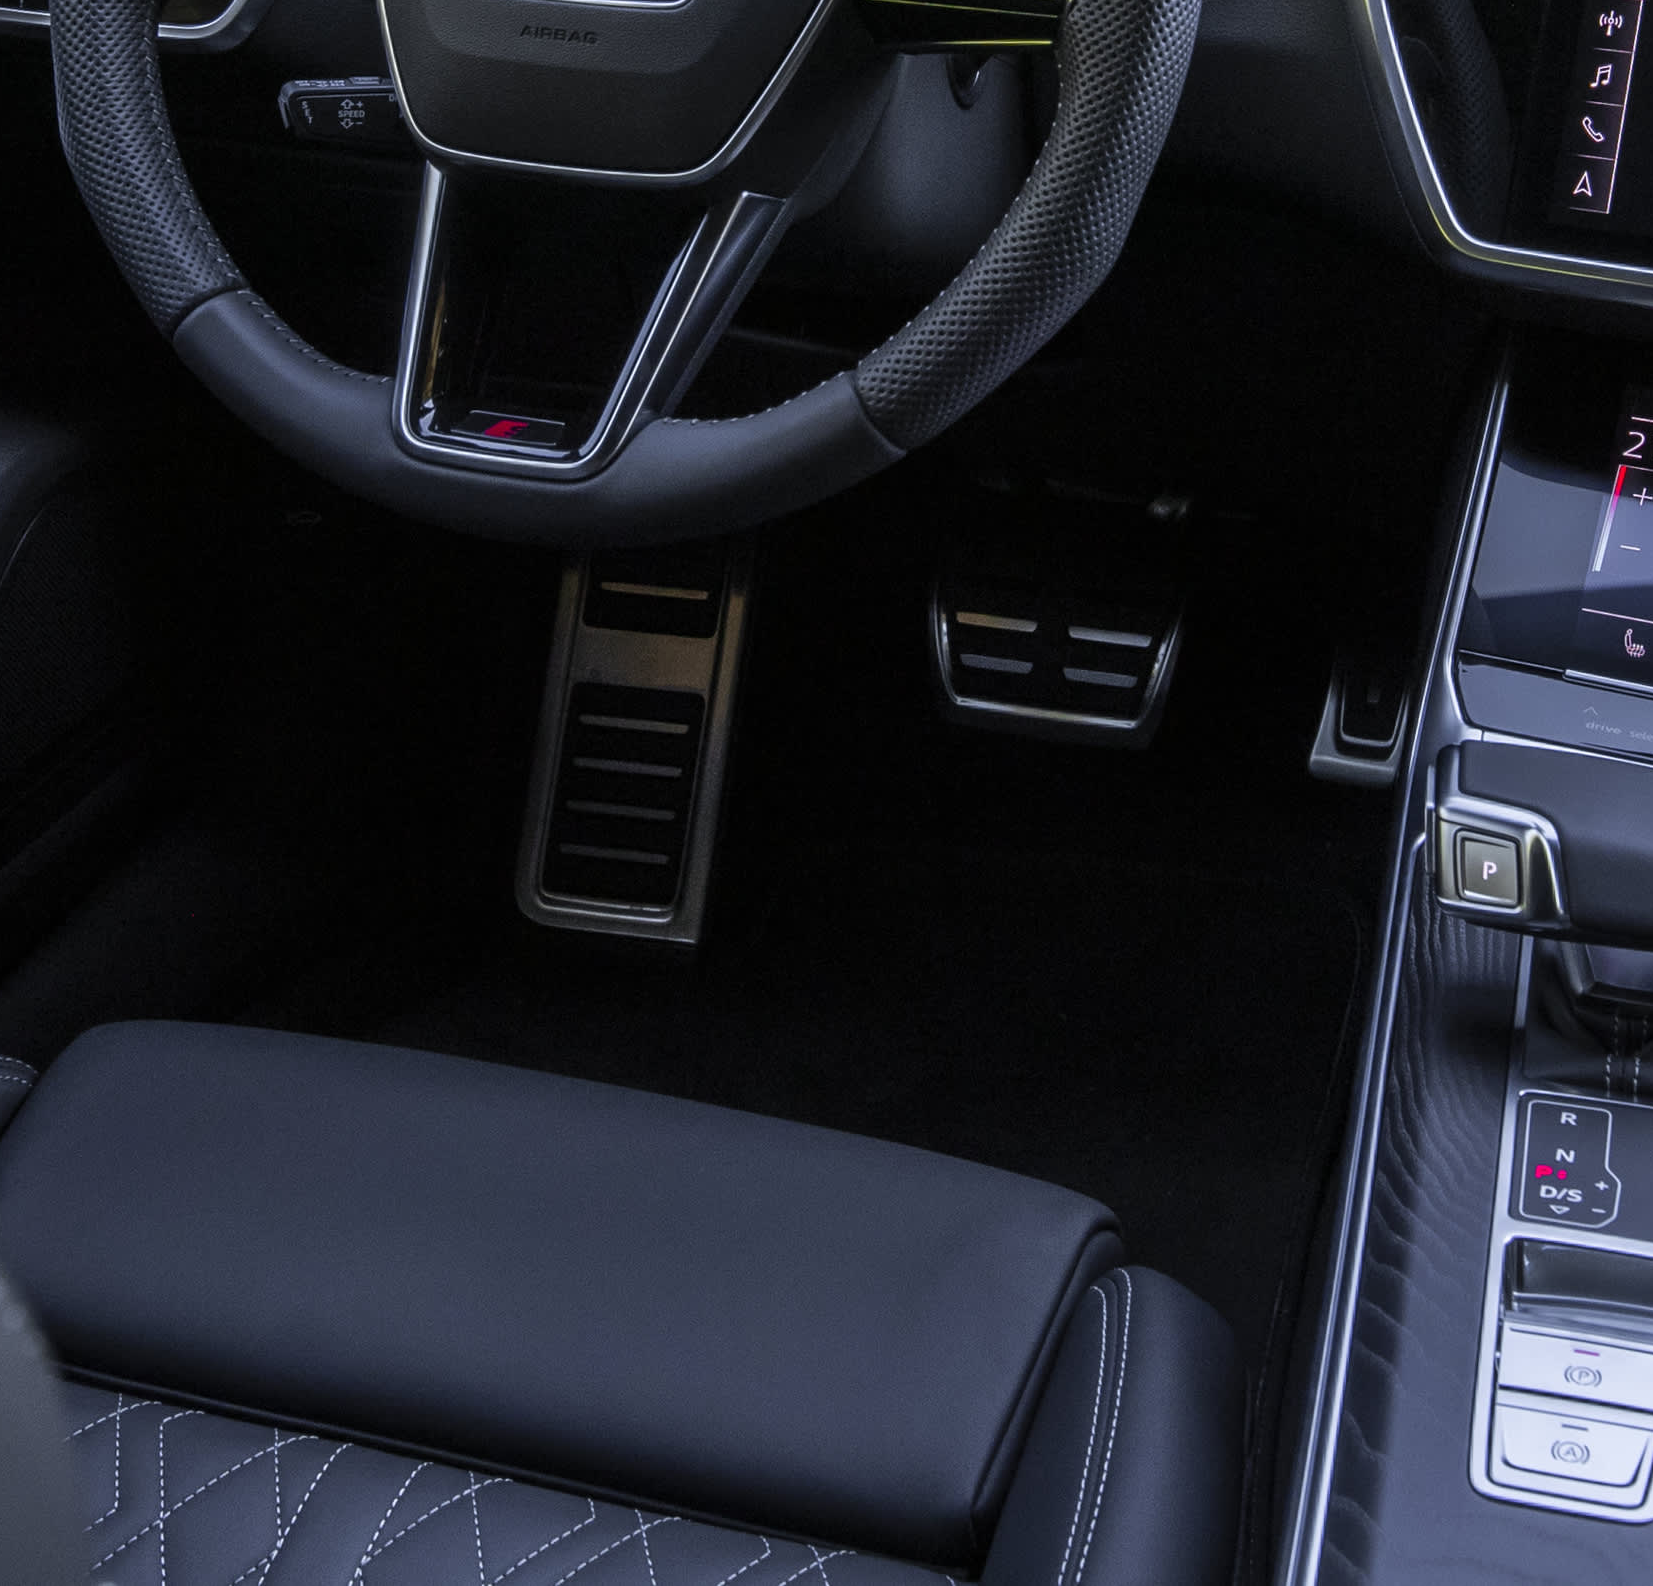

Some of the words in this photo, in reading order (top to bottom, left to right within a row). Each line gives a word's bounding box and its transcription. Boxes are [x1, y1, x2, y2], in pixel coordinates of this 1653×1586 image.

[520, 25, 598, 45] AIRBAG
[337, 110, 366, 118] SPEED
[1585, 720, 1622, 735] drive
[1482, 861, 1498, 881] P
[1560, 1111, 1578, 1127] R
[1555, 1147, 1576, 1164] N
[1534, 1164, 1554, 1179] P
[1539, 1184, 1583, 1203] D/S
